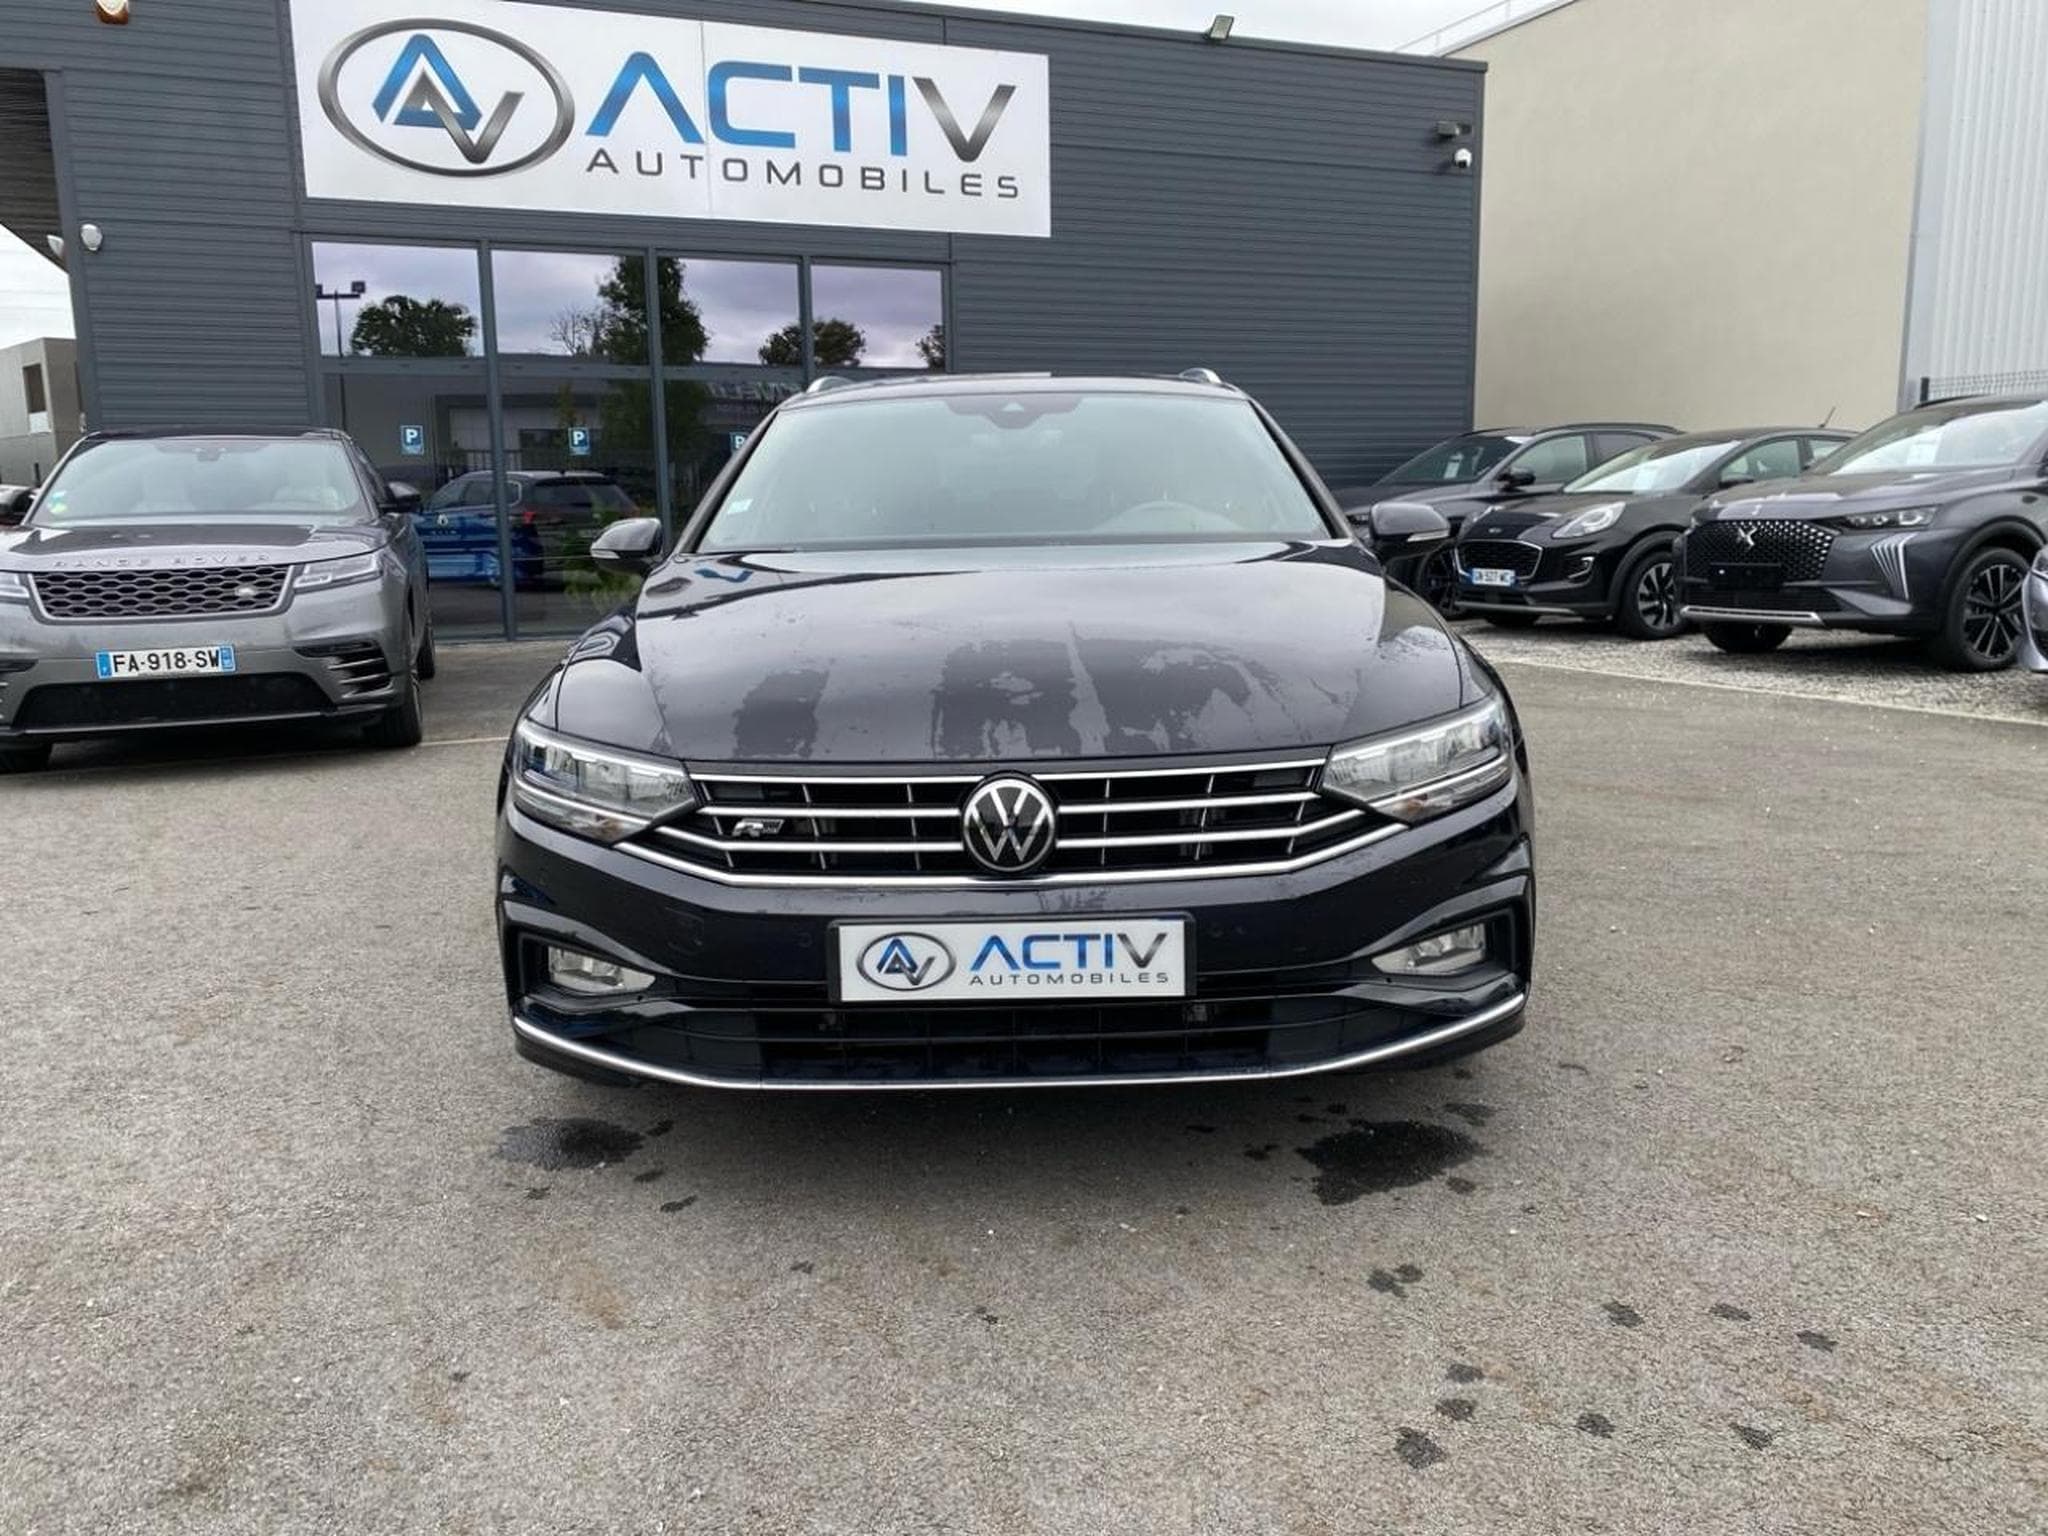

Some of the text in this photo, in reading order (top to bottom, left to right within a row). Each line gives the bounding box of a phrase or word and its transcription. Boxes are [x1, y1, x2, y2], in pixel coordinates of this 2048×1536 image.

[585, 51, 1016, 163] ACTIV
[586, 148, 1018, 198] AUTOMOBILES
[406, 428, 417, 443] P
[573, 431, 584, 445] P
[735, 435, 746, 449] P
[113, 650, 219, 672] FA-918-SW
[970, 933, 1167, 971] ACTIV
[970, 972, 1168, 985] AUTOMOBILES
